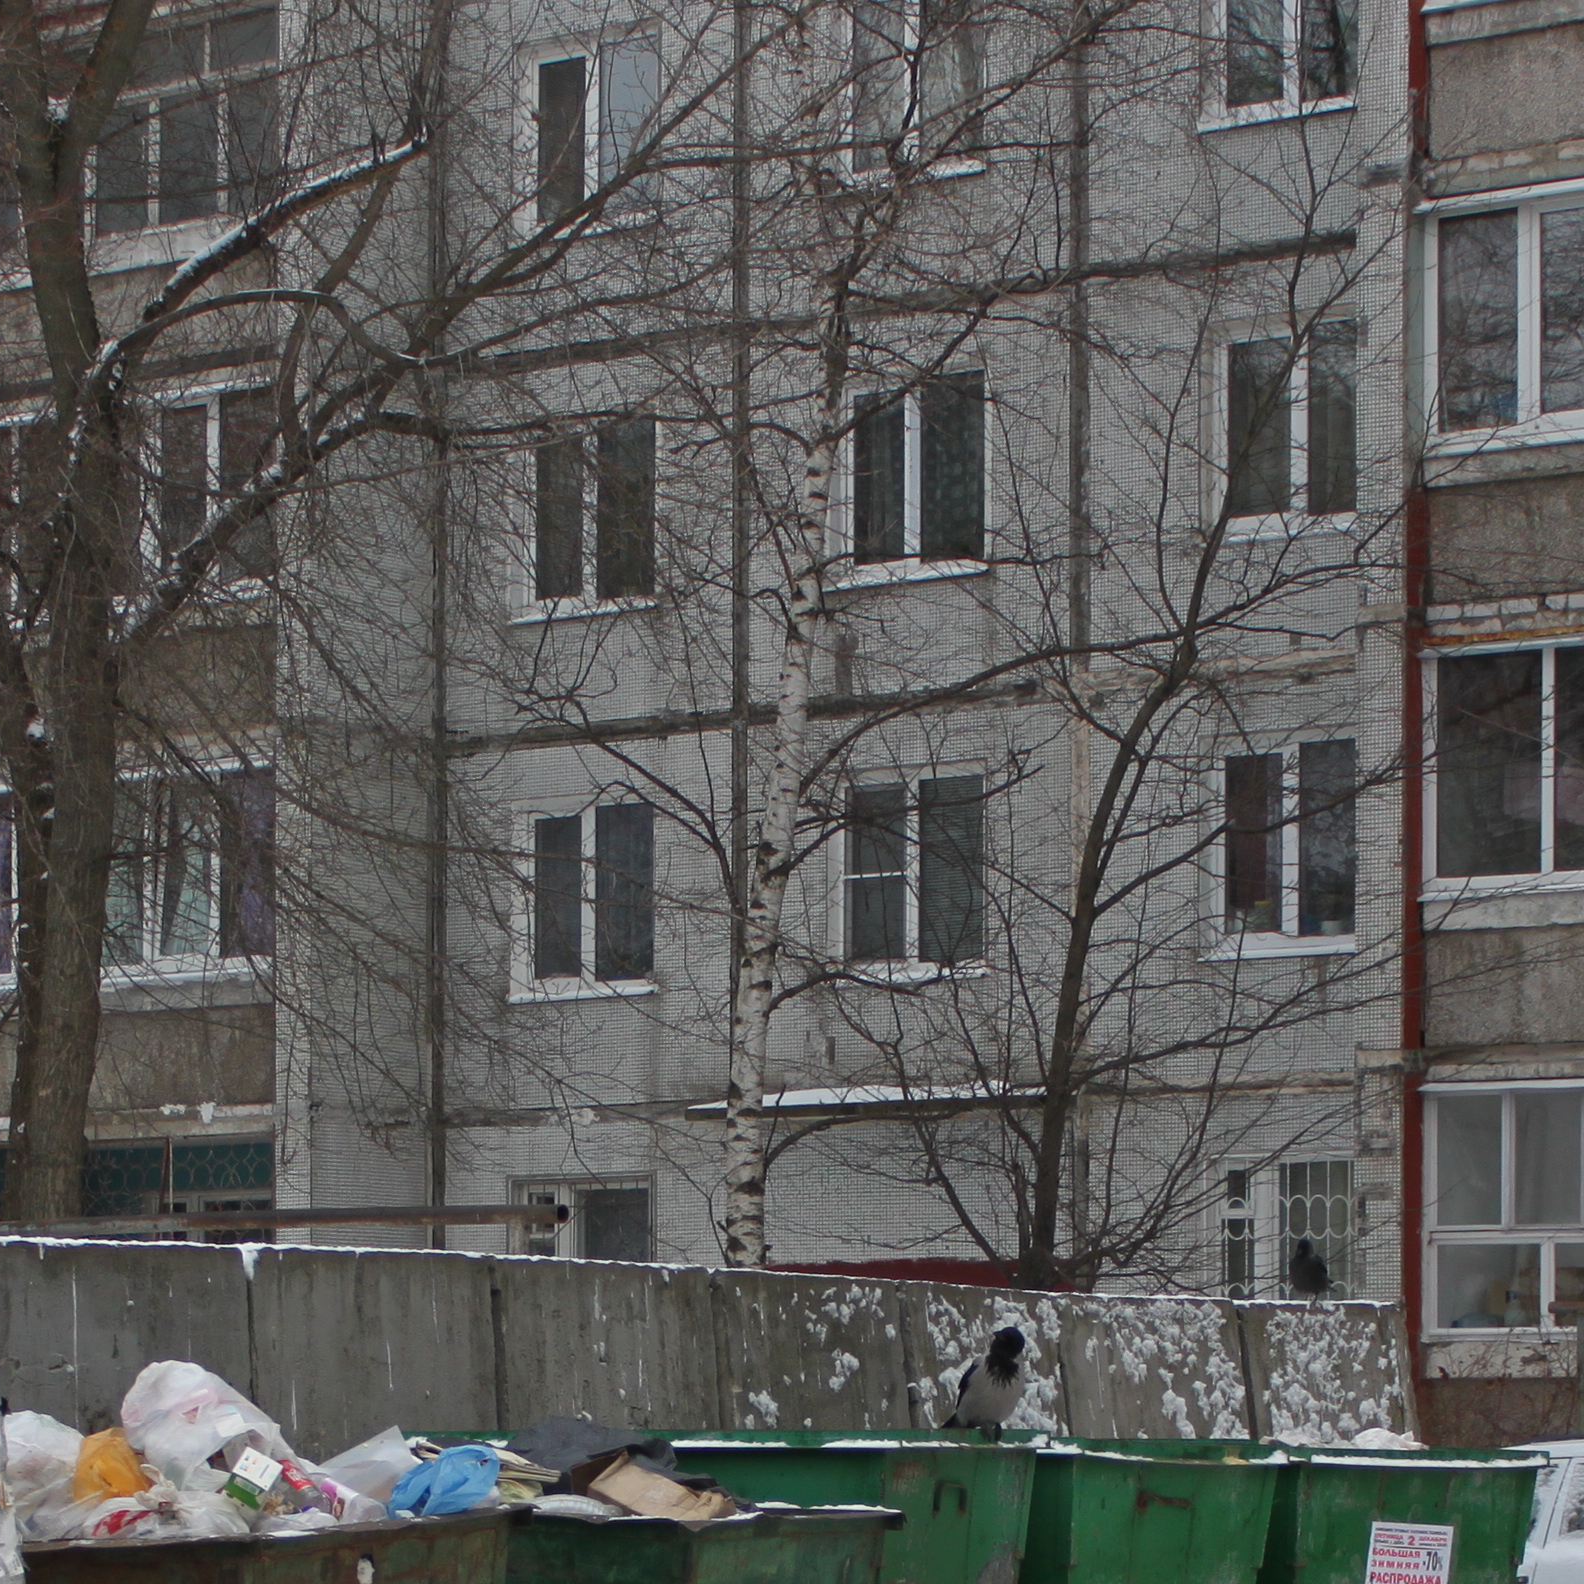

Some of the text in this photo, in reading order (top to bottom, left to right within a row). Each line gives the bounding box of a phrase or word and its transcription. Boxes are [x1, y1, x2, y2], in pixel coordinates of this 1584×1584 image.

[1407, 1535, 1415, 1546] 2
[1372, 1547, 1421, 1559] БОЛЬШАЯ
[1370, 1560, 1420, 1570] ЗИМНЯЯ
